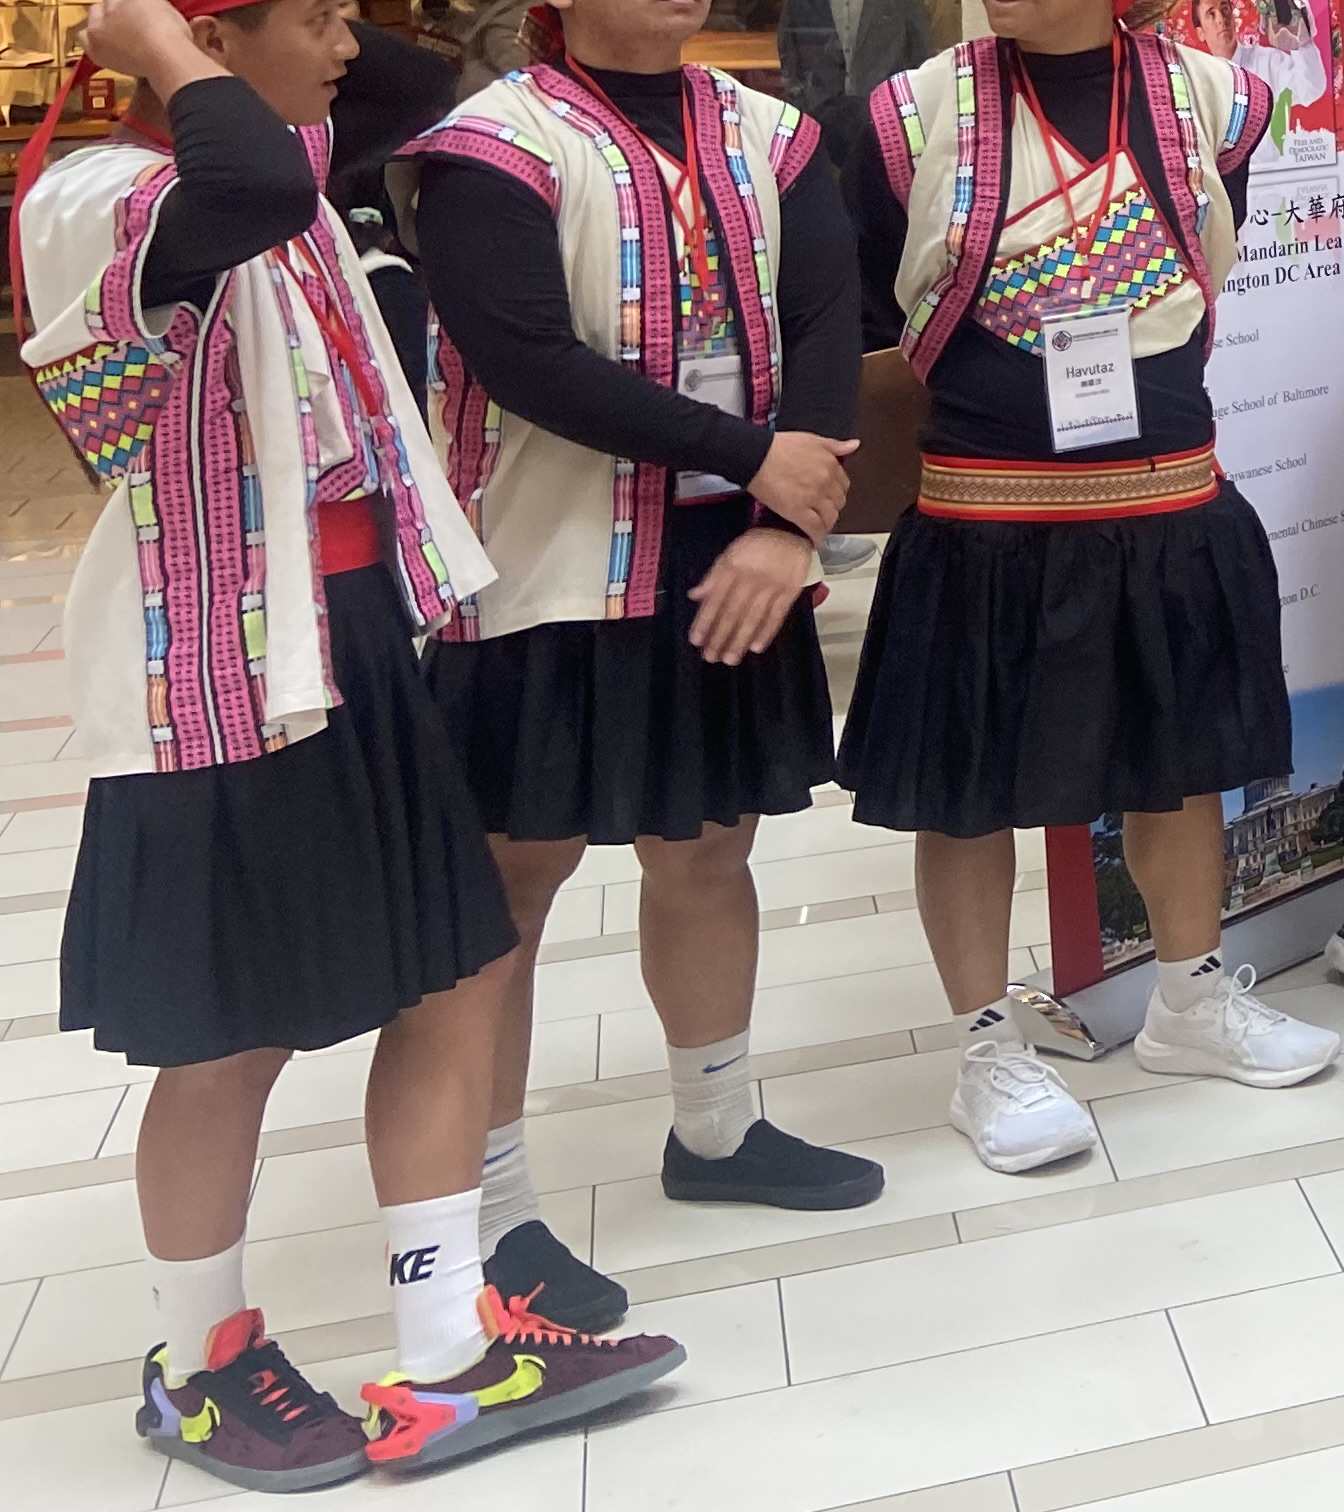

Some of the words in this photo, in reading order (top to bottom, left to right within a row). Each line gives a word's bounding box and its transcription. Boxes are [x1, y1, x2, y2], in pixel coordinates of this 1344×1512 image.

[1275, 264, 1300, 285] DC
[1304, 261, 1341, 280] Area
[1226, 329, 1260, 347] School
[1066, 361, 1115, 380] Havutaz
[1232, 395, 1265, 414] School
[1267, 391, 1279, 406] of
[1283, 385, 1330, 403] Baltimore
[1275, 453, 1307, 473] School
[1301, 514, 1338, 533] Chinese
[390, 1244, 441, 1287] KE
